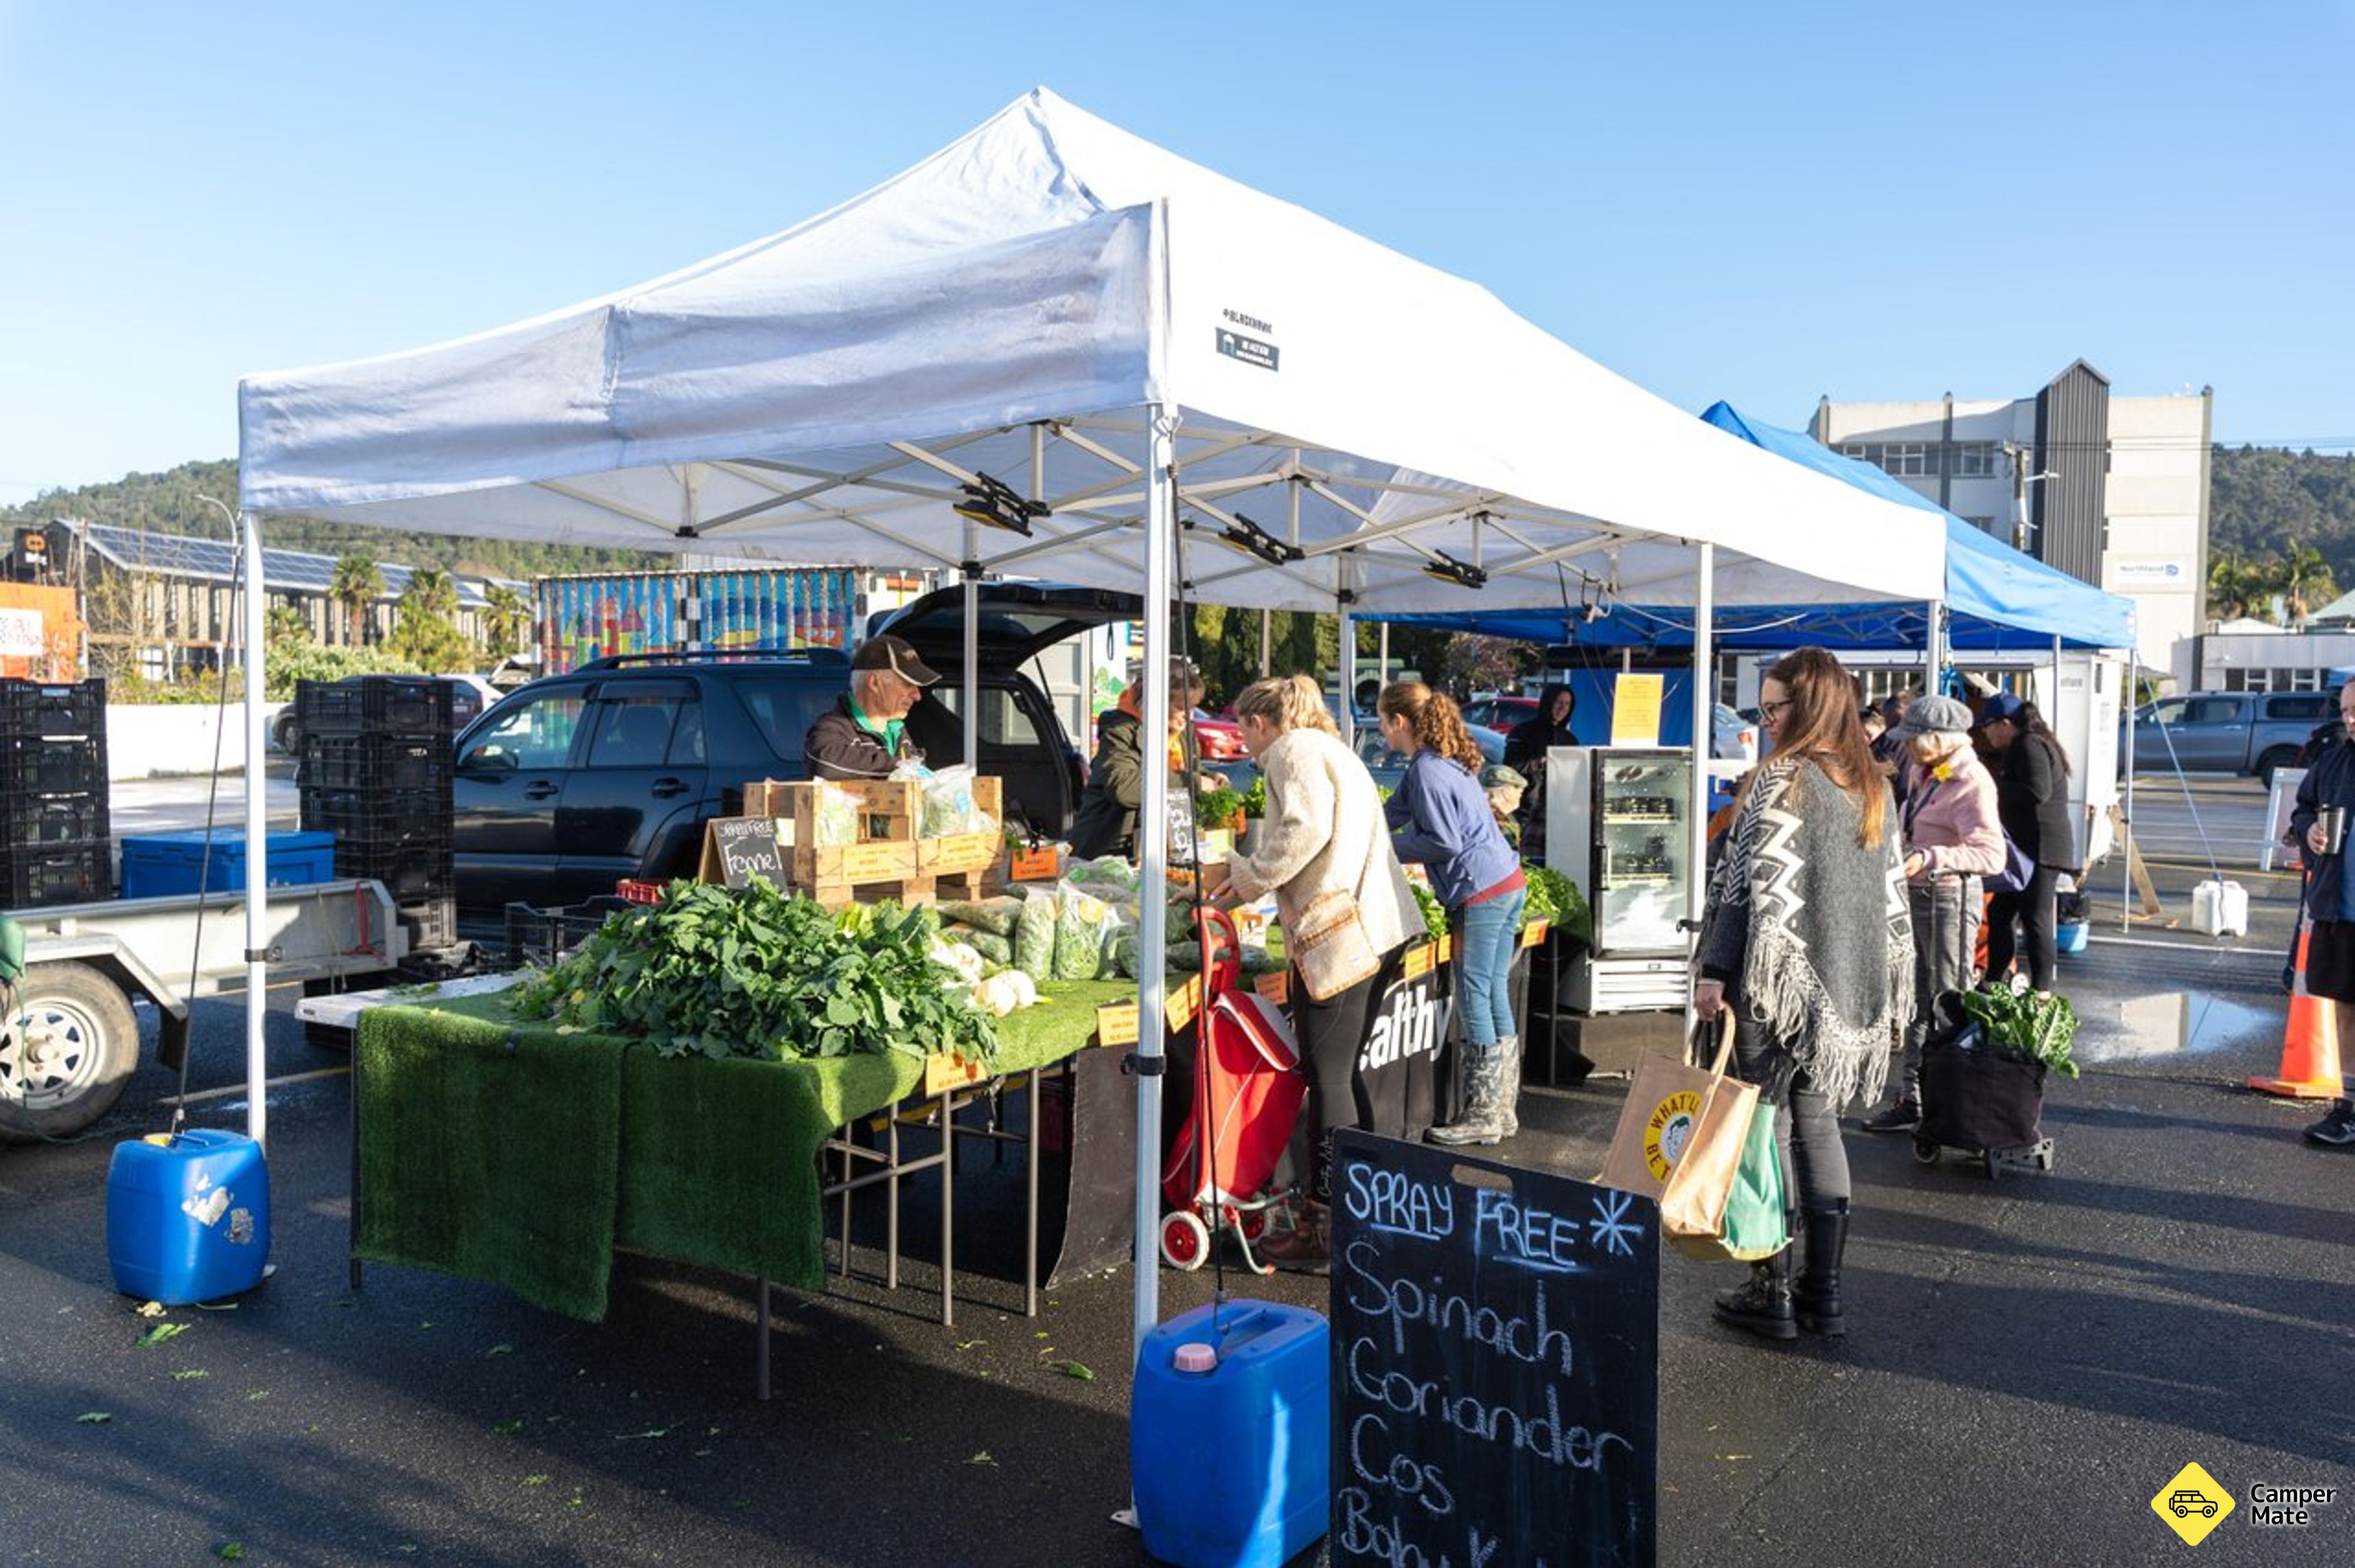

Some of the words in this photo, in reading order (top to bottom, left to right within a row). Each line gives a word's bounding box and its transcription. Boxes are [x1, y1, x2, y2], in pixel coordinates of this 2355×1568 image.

[1646, 1143, 1663, 1168] BE
[1345, 1164, 1454, 1236] SPRAY
[1474, 1188, 1580, 1267] FREE
[1346, 1240, 1573, 1376] Spinach
[1350, 1336, 1635, 1473] Coriander
[1352, 1413, 1455, 1514] Cos
